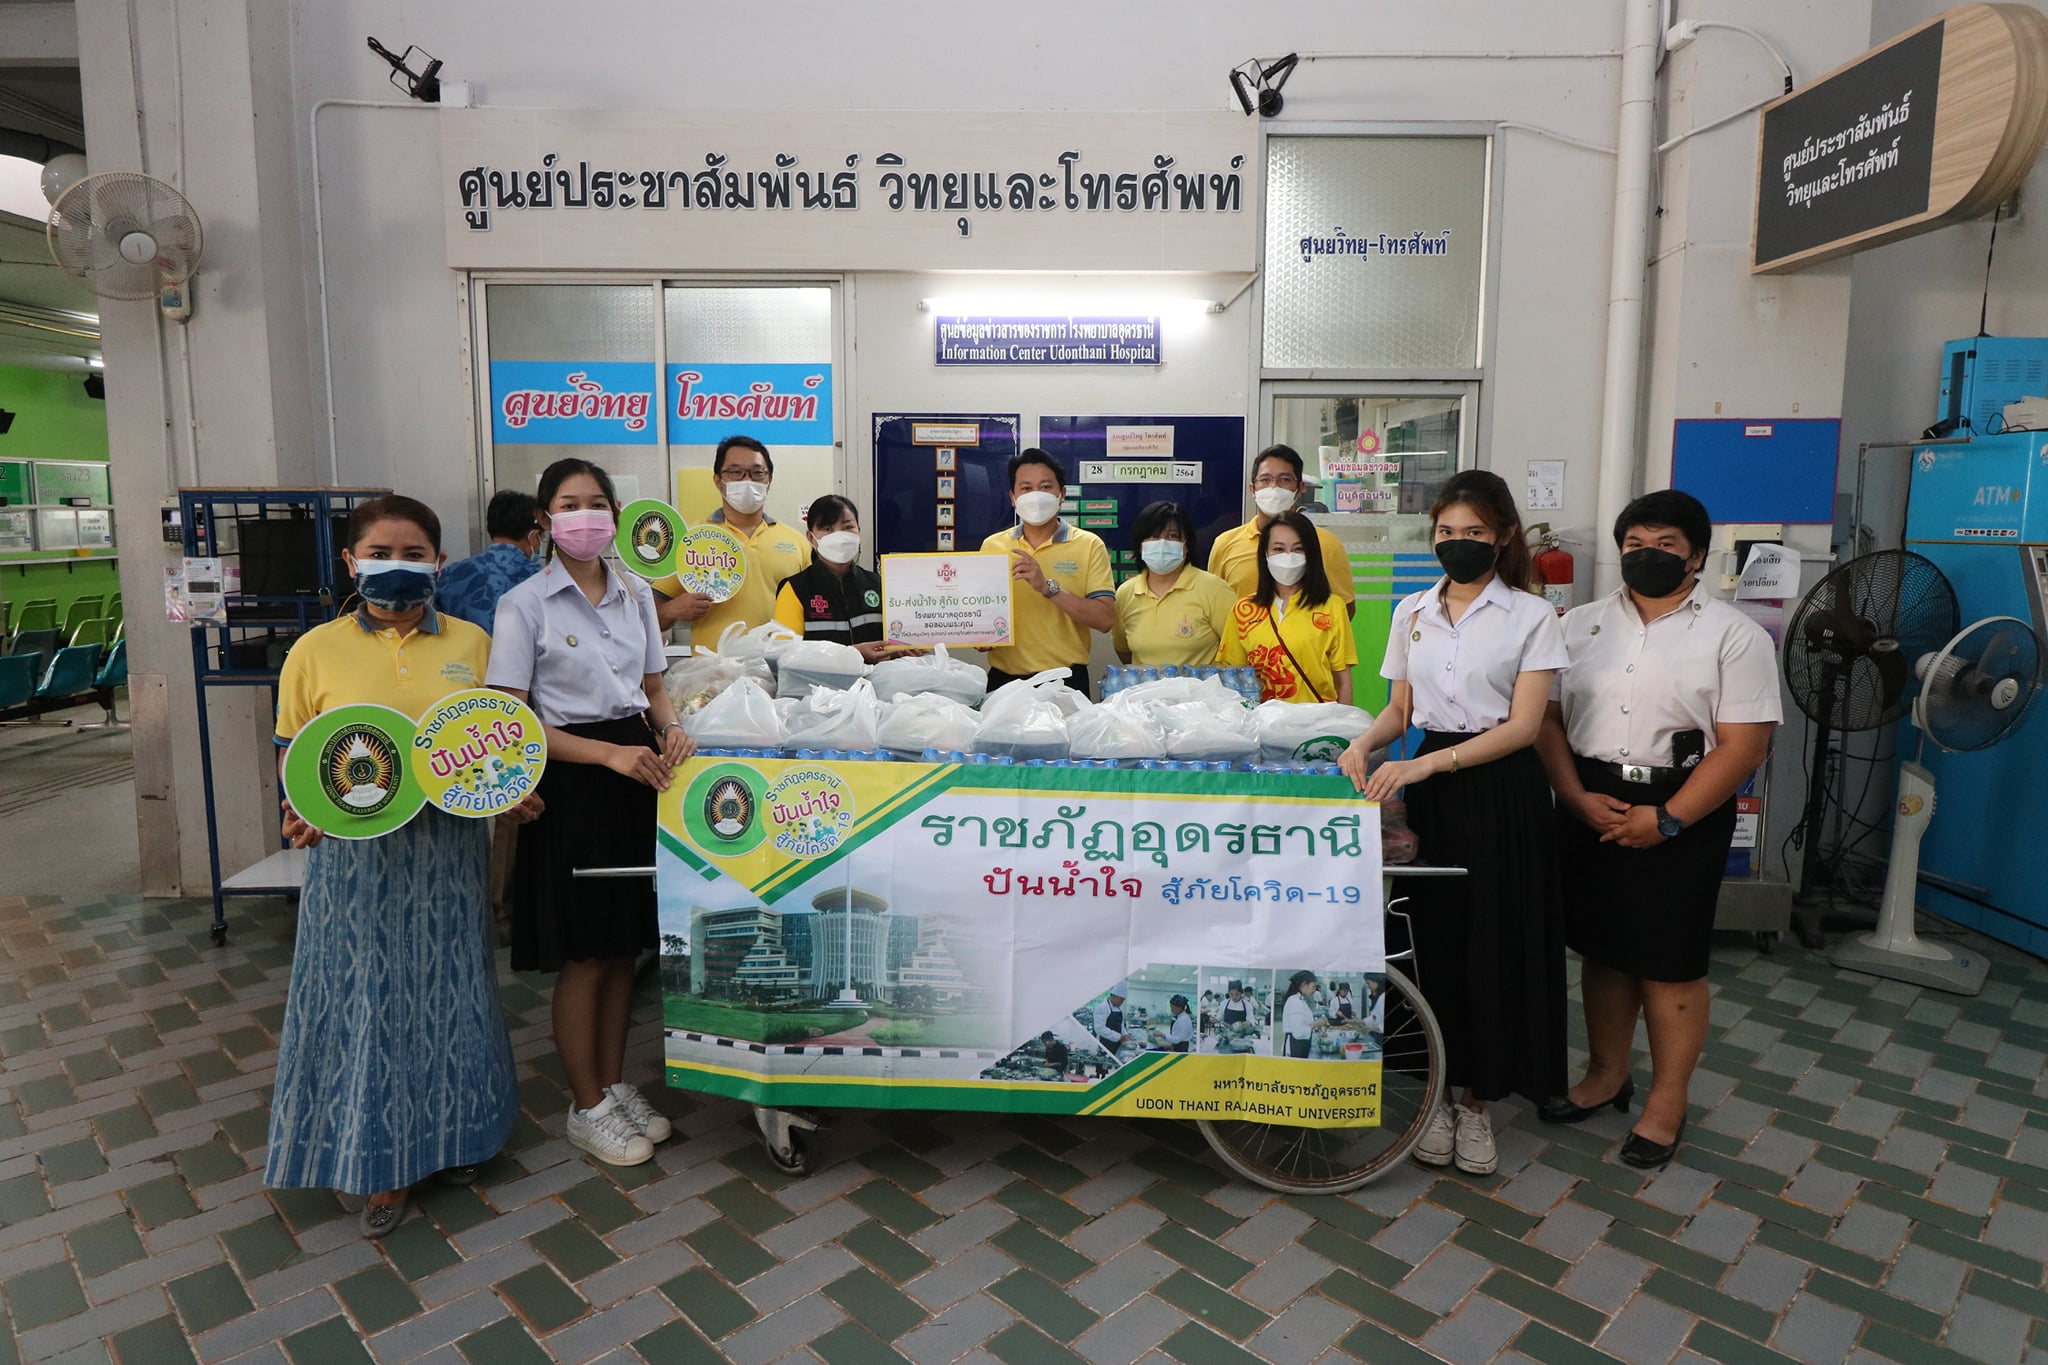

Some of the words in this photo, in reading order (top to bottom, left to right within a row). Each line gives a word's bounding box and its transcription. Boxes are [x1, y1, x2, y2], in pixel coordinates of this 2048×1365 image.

[1783, 90, 1912, 182] ศูนย์ประชาสัมพันธ์
[1786, 136, 1901, 208] วิทยุและโทรศัพท์
[458, 151, 861, 232] ศูนย์ประชาสัมพันธ์
[874, 150, 1246, 238] วิทยุและโทรศัพท์
[1300, 226, 1450, 263] ศูนย์วิทยุ-โทรศัพท์
[942, 345, 1006, 361] Information
[1009, 345, 1046, 361] Center
[1050, 345, 1107, 361] Udonthani
[1110, 344, 1155, 364] Hospital
[504, 371, 651, 431] ศูนย์วิทยุ
[674, 370, 825, 423] โทรศัพท์
[1091, 466, 1103, 475] 28
[1120, 466, 1167, 479] กรกฎาคม
[1175, 469, 1194, 477] 2564
[685, 547, 737, 569] ปันน้ำใจ
[962, 596, 1007, 606] COVID-19
[414, 697, 520, 749] ราชภัฏอุดรธานี
[430, 720, 524, 777] ปันน้ำใจ
[442, 743, 541, 811] สู้ภัยโควิด-19
[765, 771, 842, 802] ราชภัฏอุดรธานี
[772, 790, 841, 824] ปันน้ำใจ
[921, 805, 1362, 868] ราชภัฏอุดรธานี
[983, 861, 1143, 898] ปันน้ำใจ
[1161, 876, 1361, 905] สู้ภัยโควิด-19
[1213, 1077, 1377, 1100] มหาวิทยาลัยราชภัฏอุดรธานี
[1136, 1098, 1173, 1110] UDON
[1179, 1100, 1219, 1112] THANI
[1225, 1101, 1293, 1117] RAJABHAT
